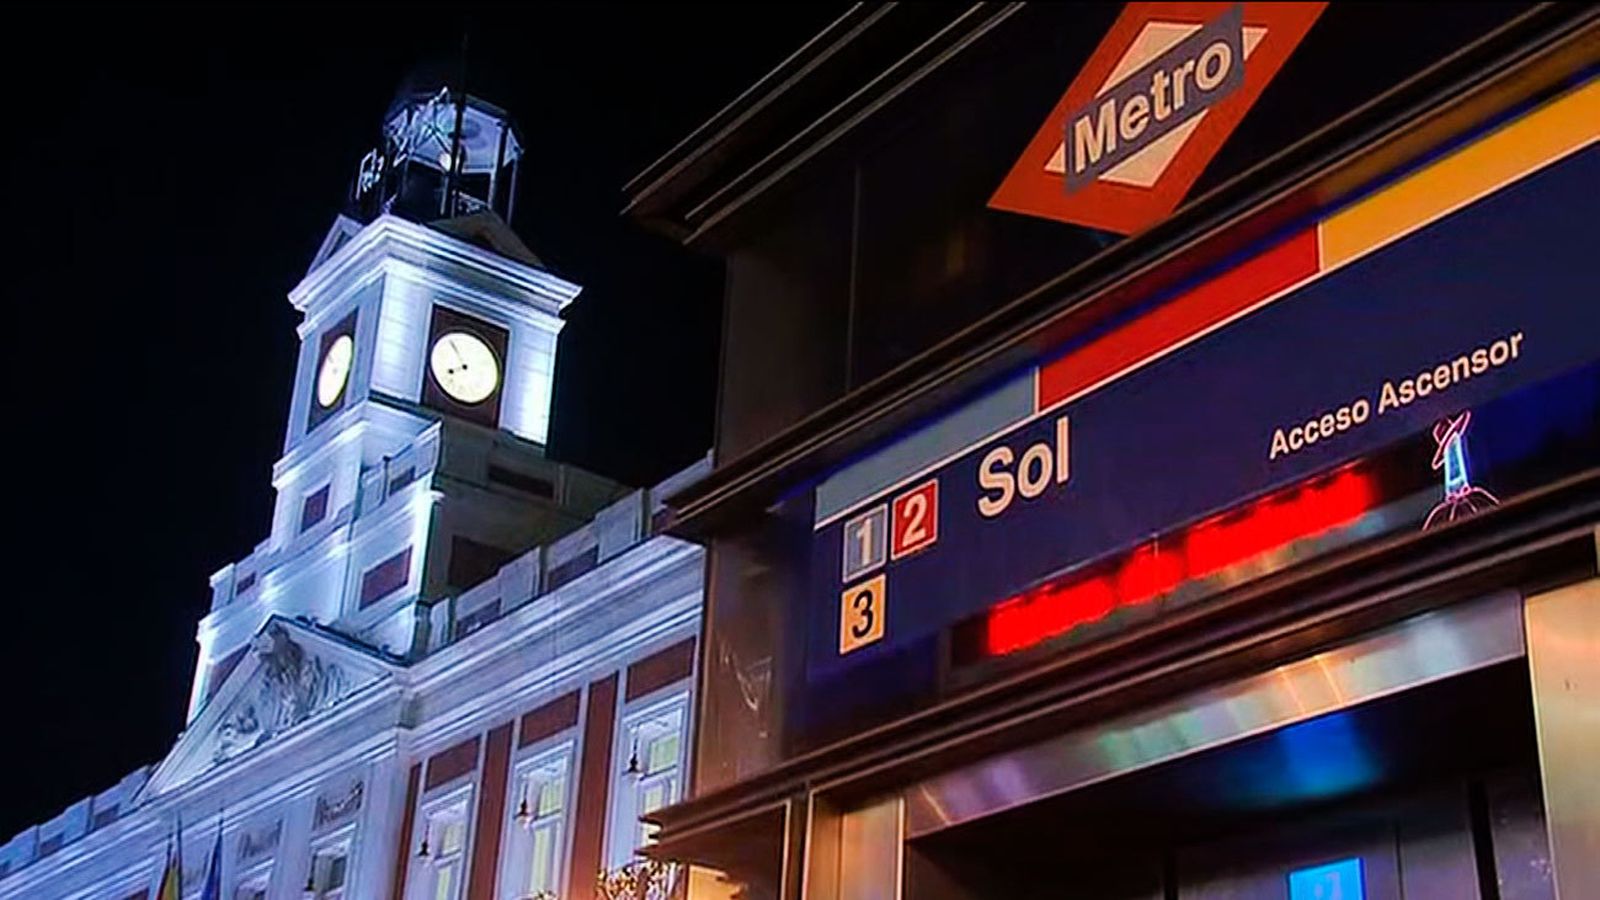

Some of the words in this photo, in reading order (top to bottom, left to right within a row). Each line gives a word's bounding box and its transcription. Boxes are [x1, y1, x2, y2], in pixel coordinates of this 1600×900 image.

[1073, 42, 1232, 174] Metro
[1269, 400, 1370, 459] Acceso
[1378, 332, 1523, 414] Ascensor
[978, 415, 1069, 517] Sol
[856, 519, 872, 566] 1
[902, 493, 927, 547] 2
[852, 589, 873, 638] 3
